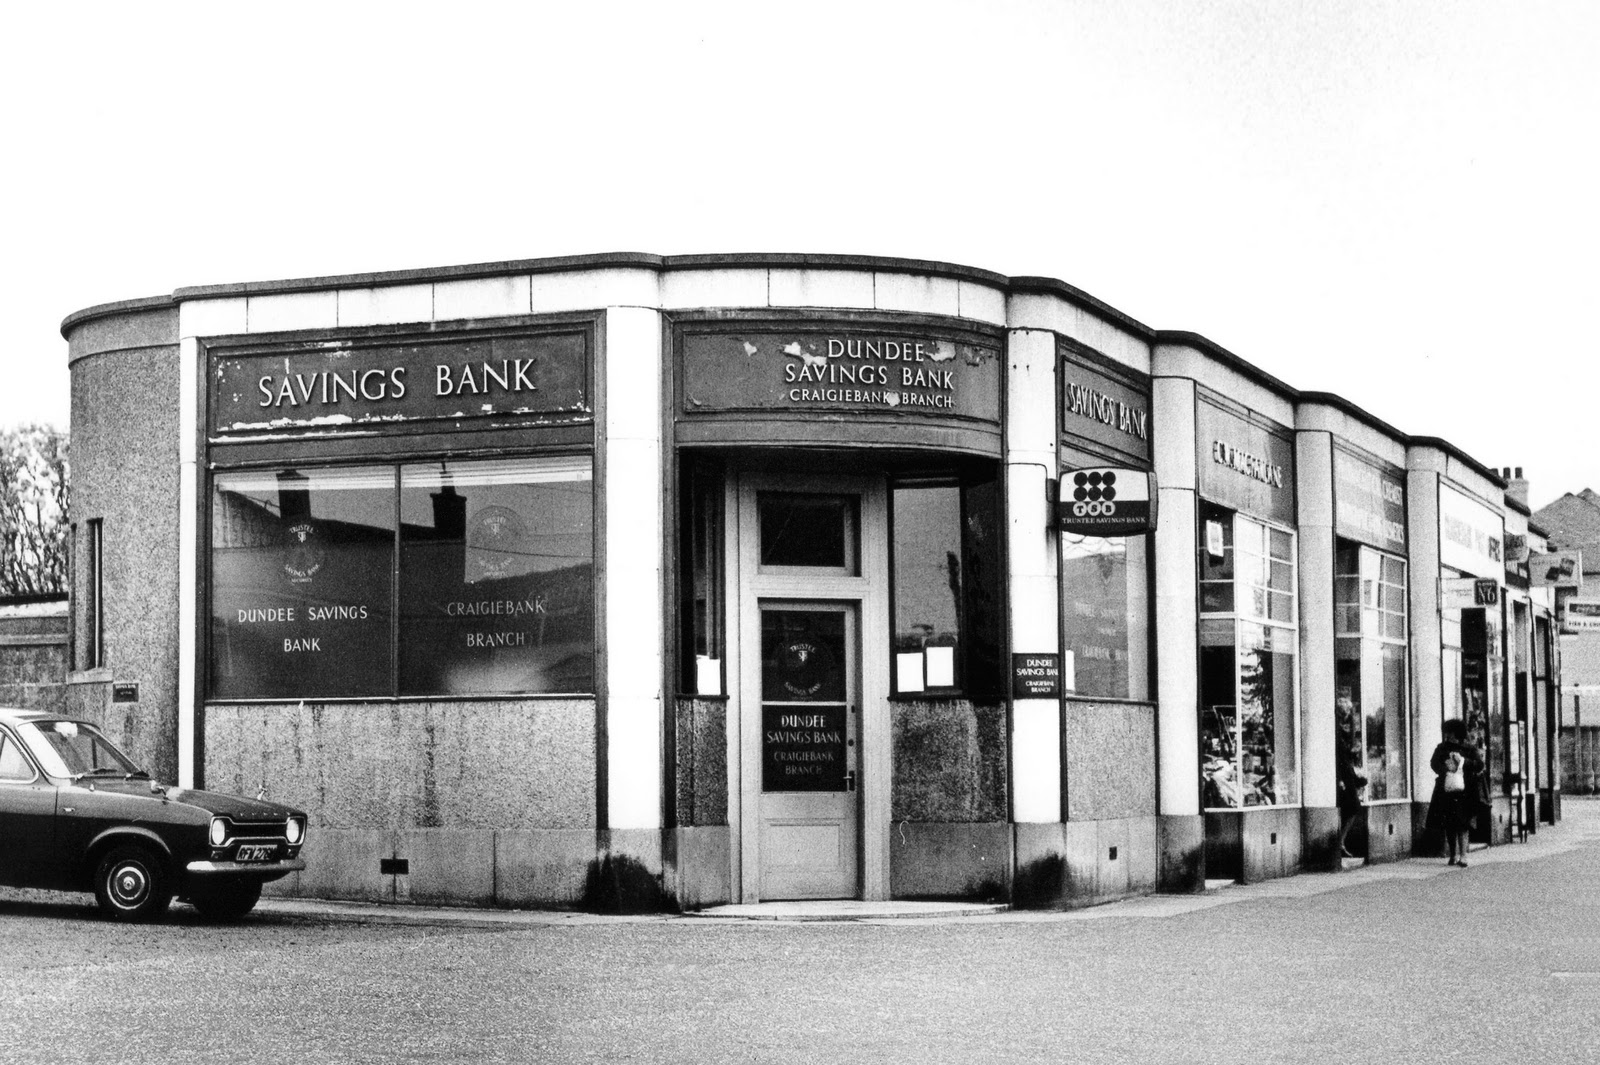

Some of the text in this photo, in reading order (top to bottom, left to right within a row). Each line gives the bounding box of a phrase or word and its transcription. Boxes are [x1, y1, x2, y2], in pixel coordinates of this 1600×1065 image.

[827, 339, 925, 363] DUNDEE
[258, 358, 537, 408] SAVINGS BANK
[785, 363, 954, 390] SAVINGS BANK
[789, 388, 952, 408] CRAIGIEBANK BRANCH
[1069, 382, 1147, 440] SAVINGS BANK
[237, 605, 368, 623] DUNDEE SAVINGS
[447, 600, 546, 616] CRAIGIEBANK
[283, 637, 321, 652] BANK
[466, 632, 525, 647] BRANCH
[781, 714, 827, 728] DUNDEE
[766, 730, 841, 744] SAVINGS BANK
[773, 751, 834, 761] CRAIGIEBANK
[785, 764, 822, 775] BRANCH
